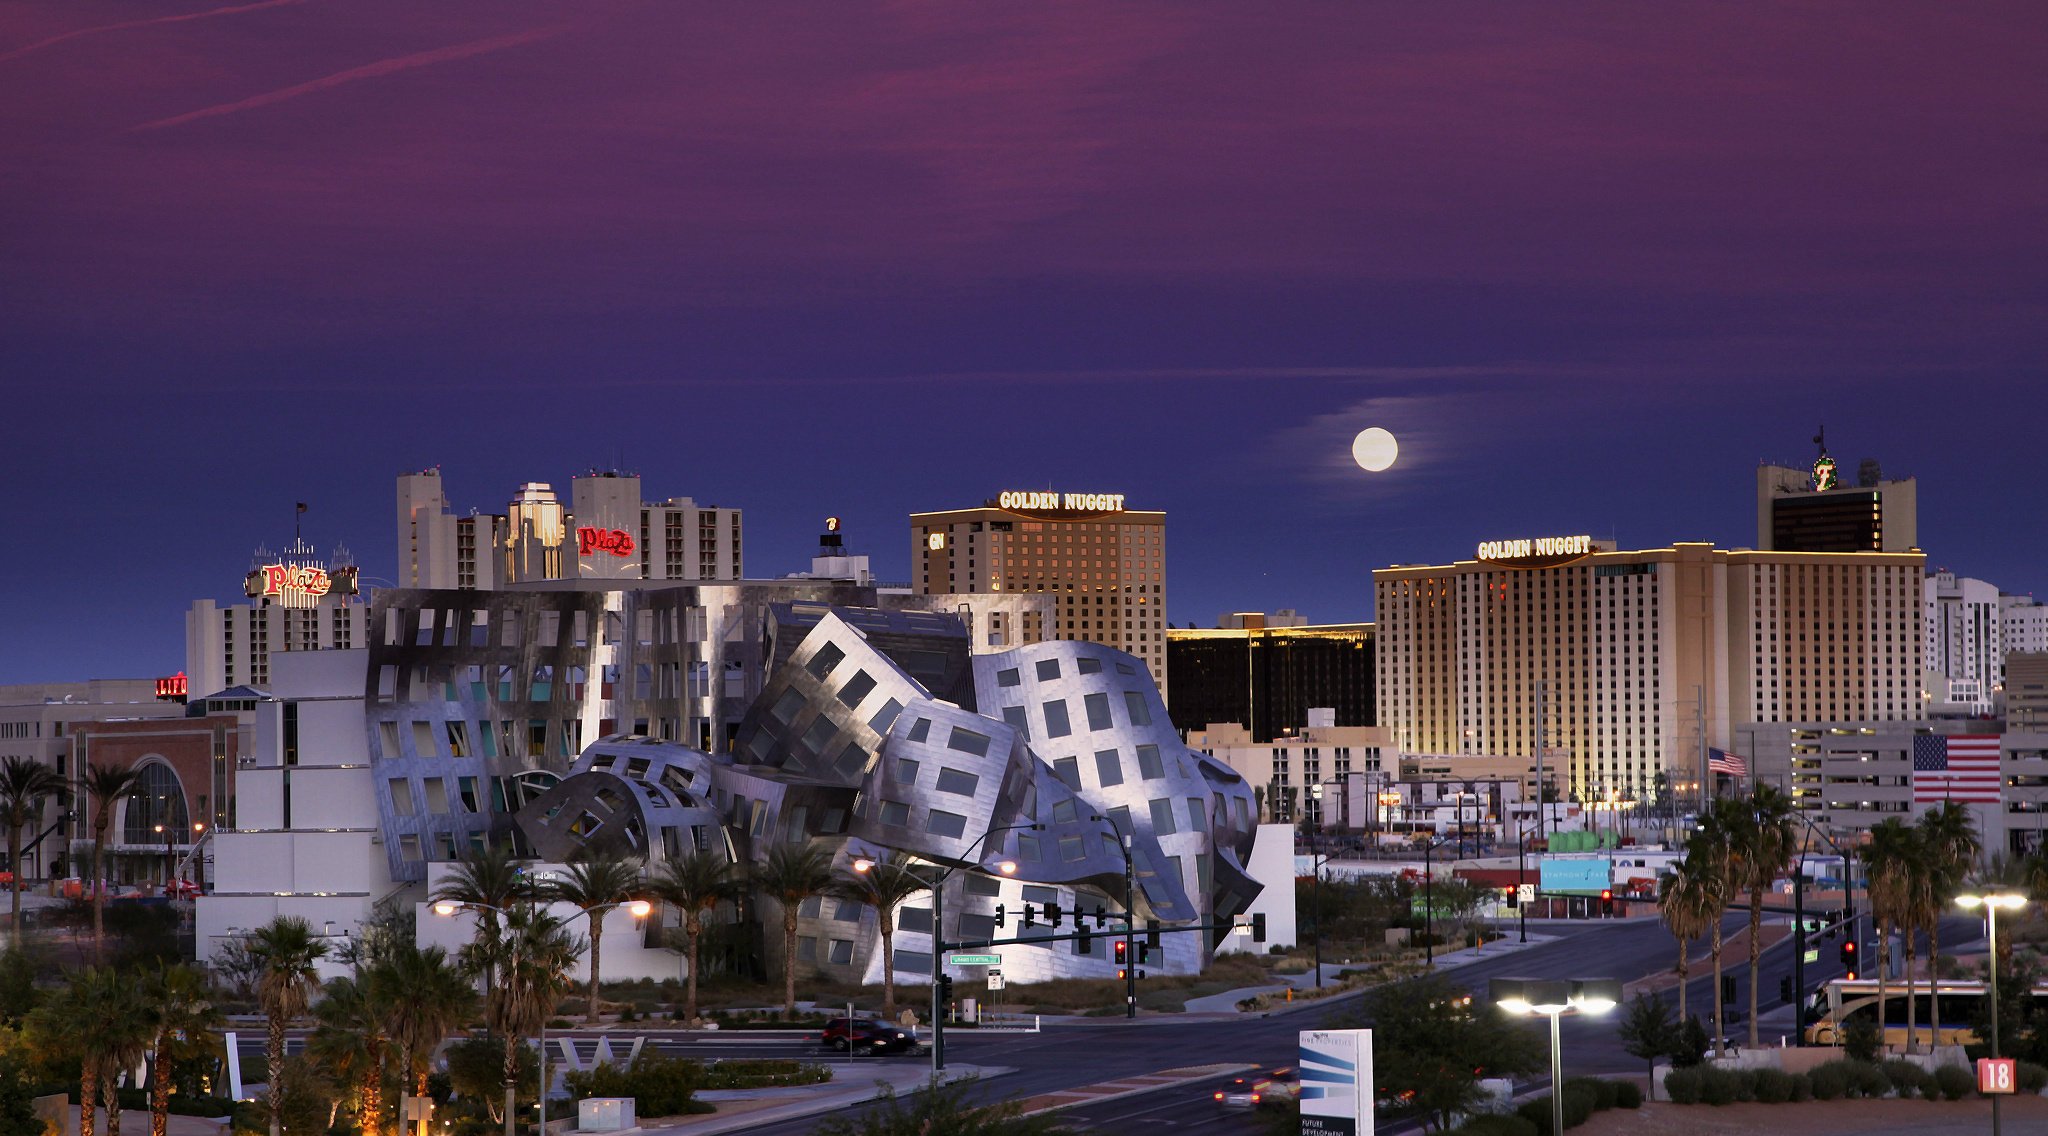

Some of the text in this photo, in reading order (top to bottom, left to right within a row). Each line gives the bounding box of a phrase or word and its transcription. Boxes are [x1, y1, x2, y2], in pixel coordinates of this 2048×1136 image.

[1000, 491, 1124, 511] GOLDEN NUGGET
[577, 526, 636, 557] Plaza
[929, 533, 944, 550] GN
[1478, 535, 1591, 560] GOLDEN NUGGET
[262, 564, 331, 596] Plaza
[1544, 871, 1585, 879] SYMPHONY
[1987, 1063, 2010, 1089] 18
[1302, 1118, 1323, 1128] FUTURE
[1302, 1128, 1344, 1136] DEVELOPMENT
